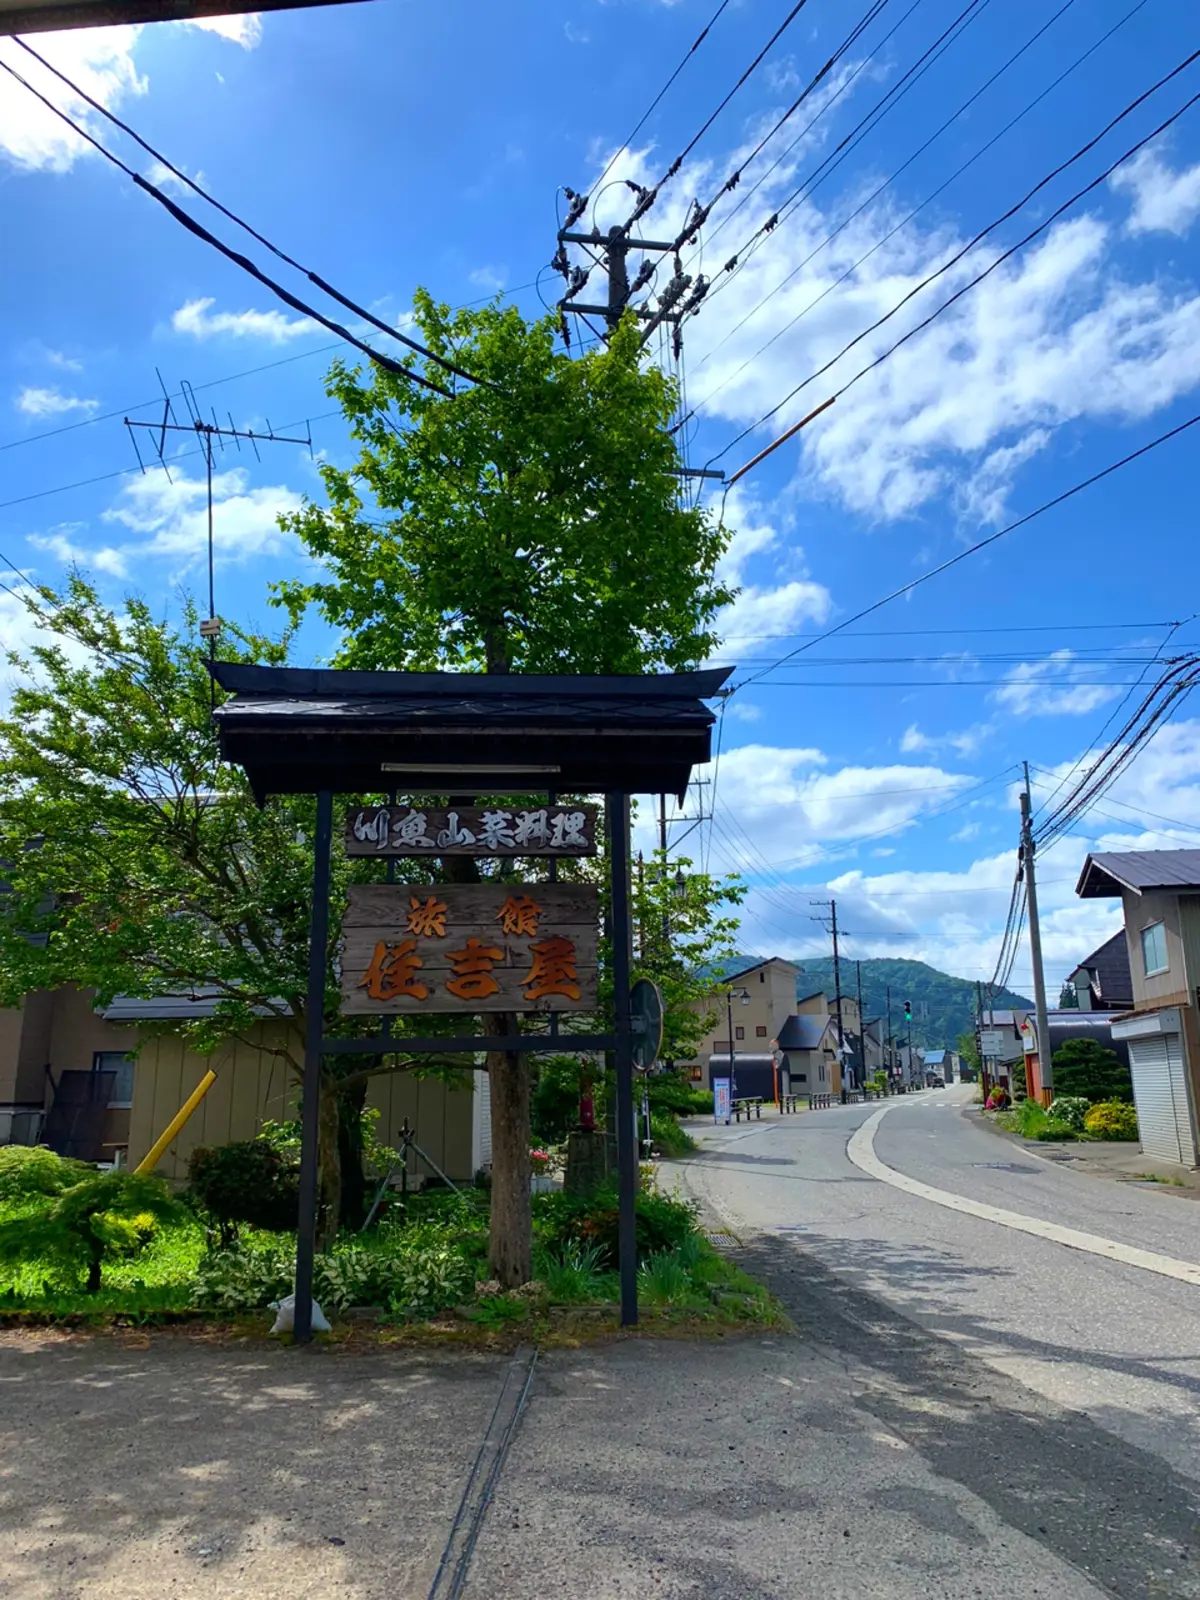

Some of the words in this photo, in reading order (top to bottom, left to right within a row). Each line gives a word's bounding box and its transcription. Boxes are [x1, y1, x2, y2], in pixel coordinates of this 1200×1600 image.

[353, 808, 589, 849] 川魚山菜料理
[403, 895, 543, 937] 旅館
[356, 937, 581, 1000] 住吉屋
